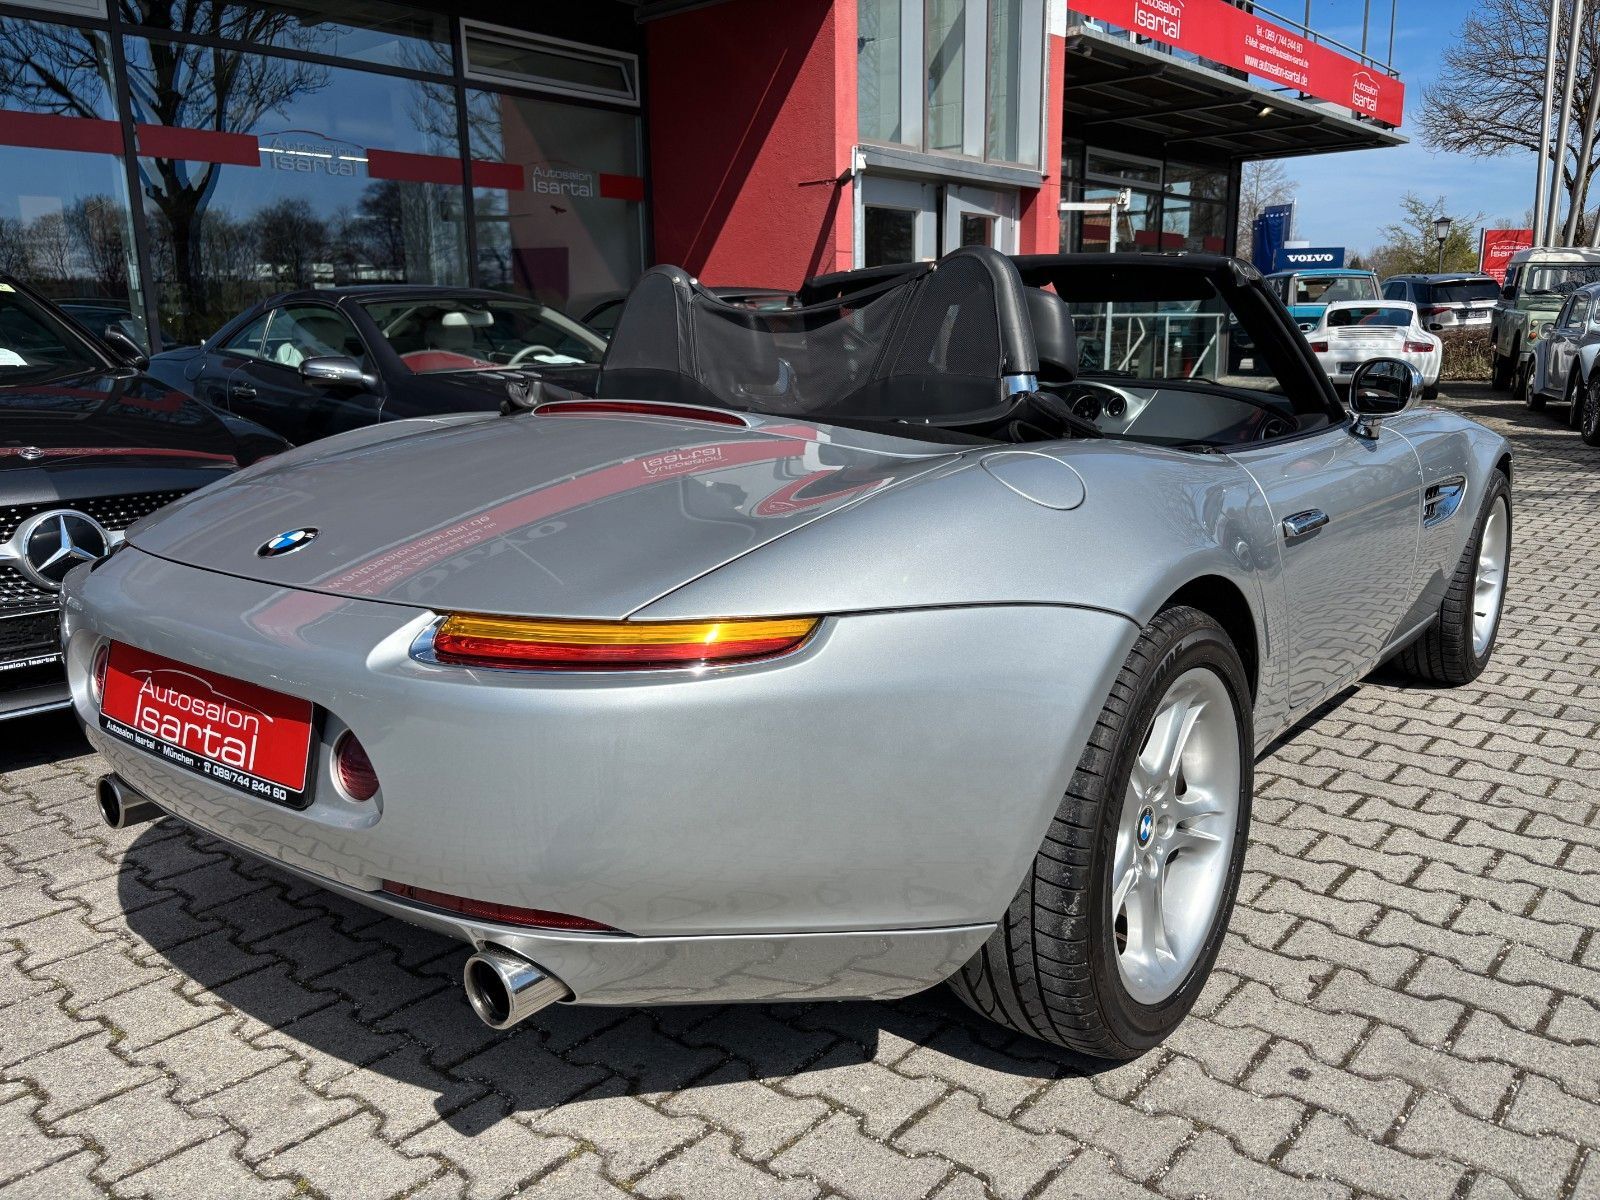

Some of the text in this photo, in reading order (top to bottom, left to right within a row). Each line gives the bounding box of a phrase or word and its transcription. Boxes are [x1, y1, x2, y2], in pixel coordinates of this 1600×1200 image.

[1134, 1, 1181, 40] Isartal
[1244, 54, 1308, 87] www.autosalon-isartal.de
[1352, 87, 1378, 112] Isartal
[1354, 78, 1378, 96] Autosalon
[271, 148, 359, 177] Isartal
[533, 166, 593, 181] Autosalon
[532, 176, 593, 198] Isartal
[1287, 253, 1334, 262] VOLVO
[28, 656, 57, 665] Isartal
[139, 676, 260, 735] Autosalon
[133, 694, 258, 771] Isartal
[106, 719, 287, 801] Autosalon Isartal München 089/744 244 60
